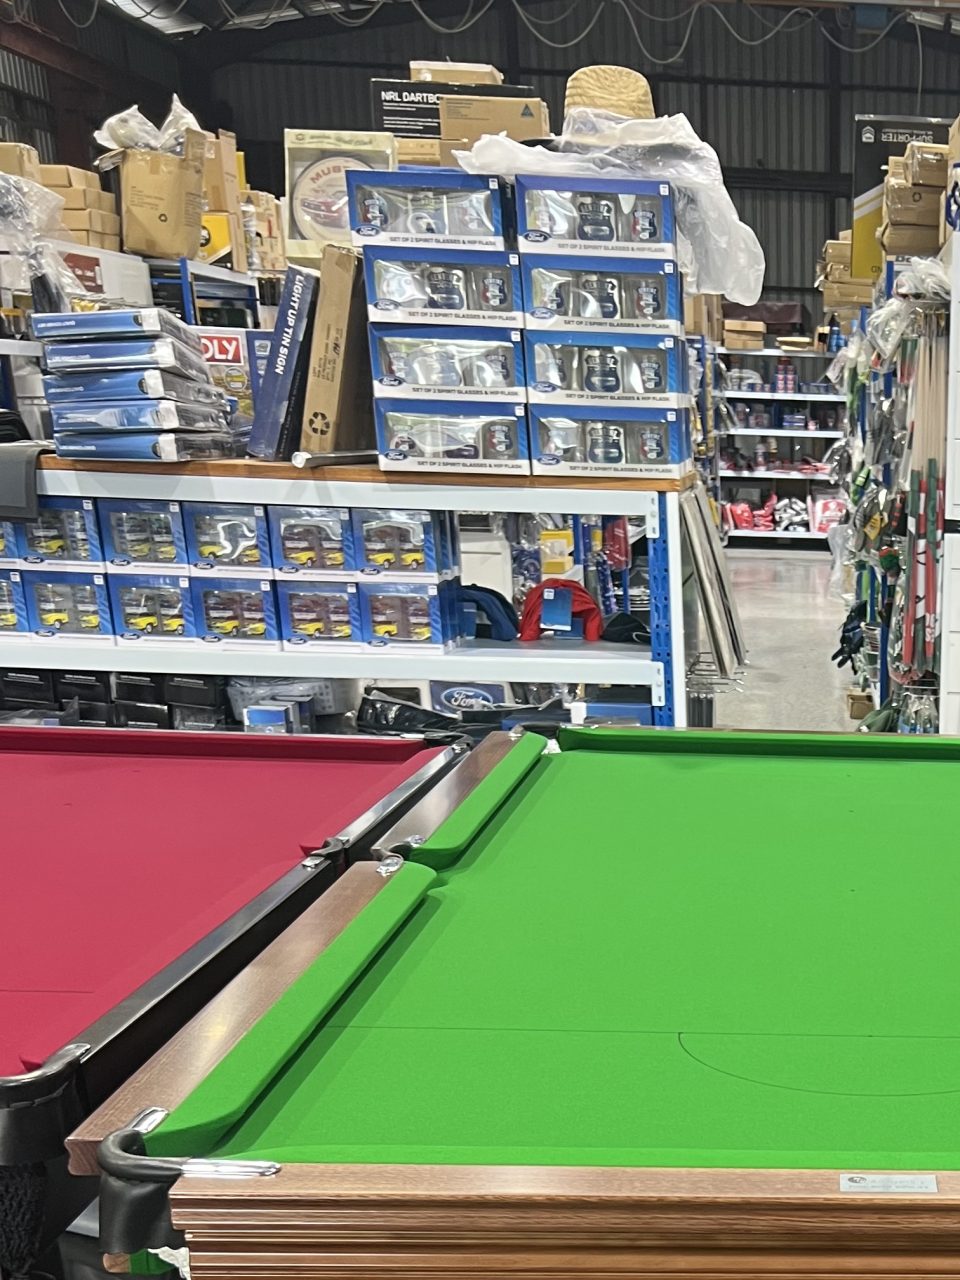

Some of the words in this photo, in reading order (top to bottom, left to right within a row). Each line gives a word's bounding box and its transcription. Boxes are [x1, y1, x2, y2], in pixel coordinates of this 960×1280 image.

[381, 91, 401, 101] NRL
[402, 92, 440, 103] DARTBO
[290, 274, 304, 309] LIGHT
[286, 309, 297, 326] UP
[281, 327, 293, 346] TIN
[274, 346, 288, 374] SIGN
